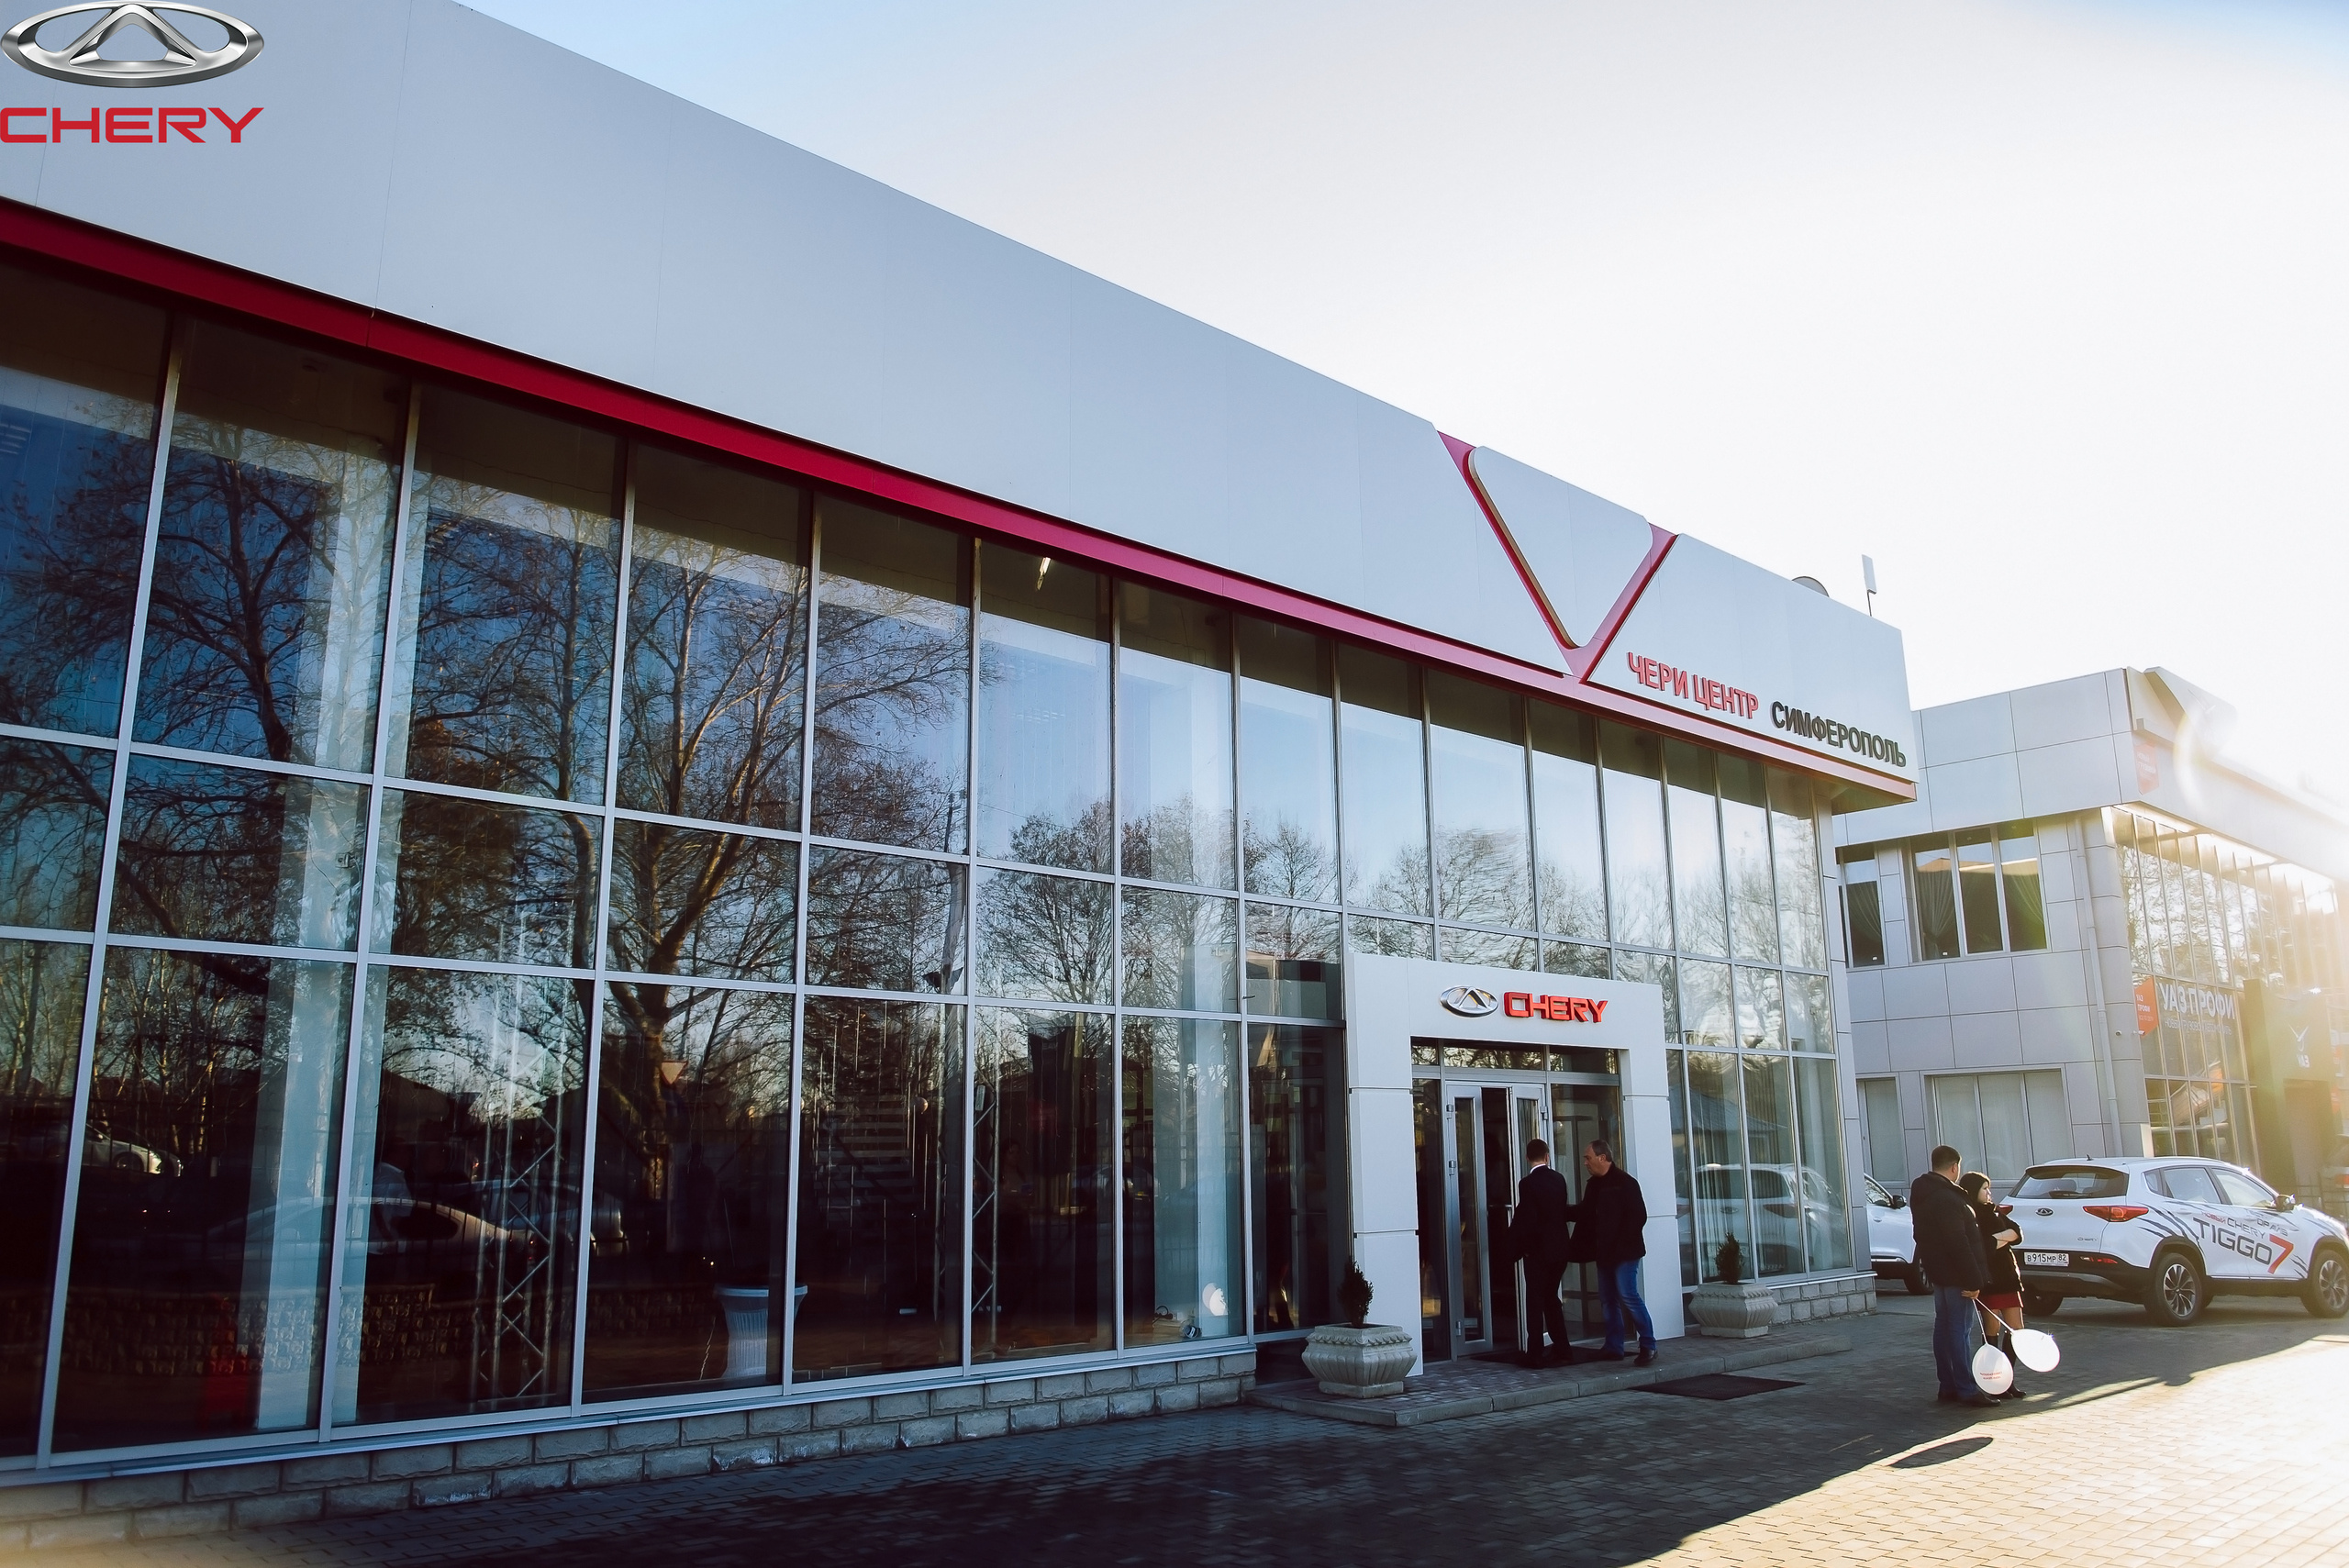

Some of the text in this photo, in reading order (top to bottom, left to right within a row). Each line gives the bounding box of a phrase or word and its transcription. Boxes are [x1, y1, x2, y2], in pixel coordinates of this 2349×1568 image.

[1627, 651, 1907, 768] ЧЕРИ ЦЕНТР СИМФЕРОПОЛЬ
[1503, 991, 1609, 1023] CHERY
[2158, 983, 2235, 1020] УАЗ ПРОФИ
[2193, 1217, 2273, 1265] TIGGO
[2227, 1218, 2266, 1239] CHERY
